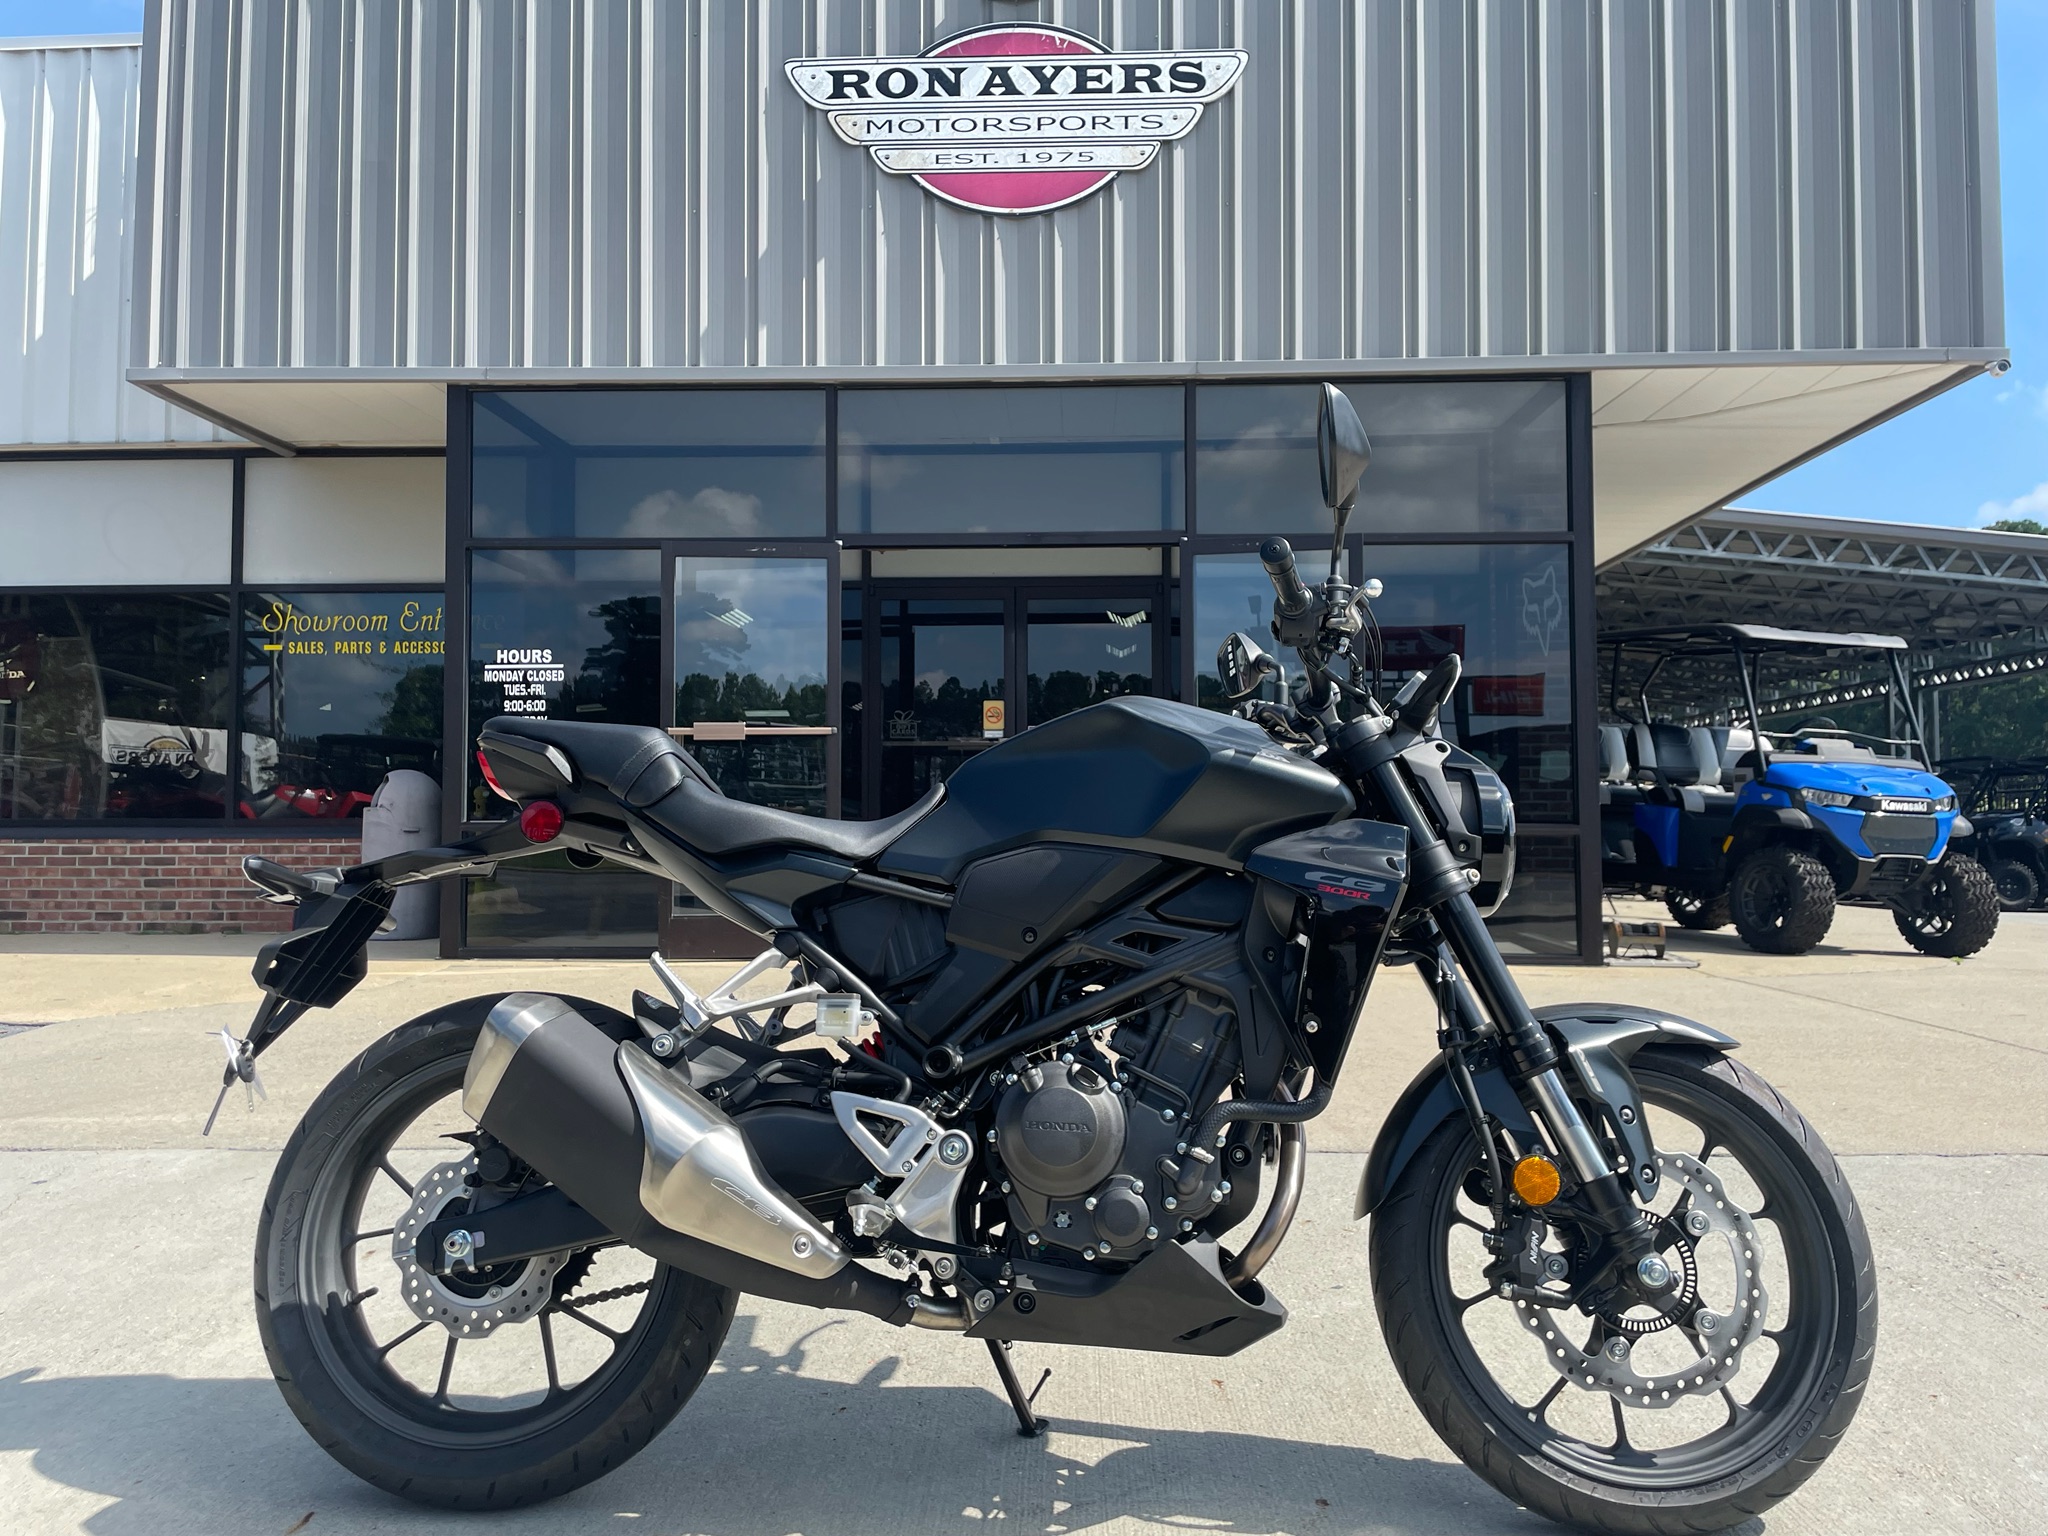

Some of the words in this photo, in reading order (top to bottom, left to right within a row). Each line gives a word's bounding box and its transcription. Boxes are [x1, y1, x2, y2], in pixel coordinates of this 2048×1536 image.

[825, 67, 968, 100] RON
[977, 61, 1207, 97] AYERS
[865, 114, 1164, 135] MOTORSPORTS
[934, 153, 998, 165] EST.
[1018, 151, 1095, 164] 1975
[262, 601, 389, 635] Showroom
[288, 641, 328, 656] SALES,
[334, 641, 372, 654] PARTS
[379, 641, 387, 654] &
[496, 649, 553, 663] HOURS
[484, 670, 525, 682] MONDAY
[526, 669, 565, 681] CLOSED
[503, 699, 547, 712] 9:00-6:00
[1881, 799, 1928, 812] Kawasaki
[1317, 883, 1371, 900] 300R
[1025, 1120, 1093, 1134] HONDA
